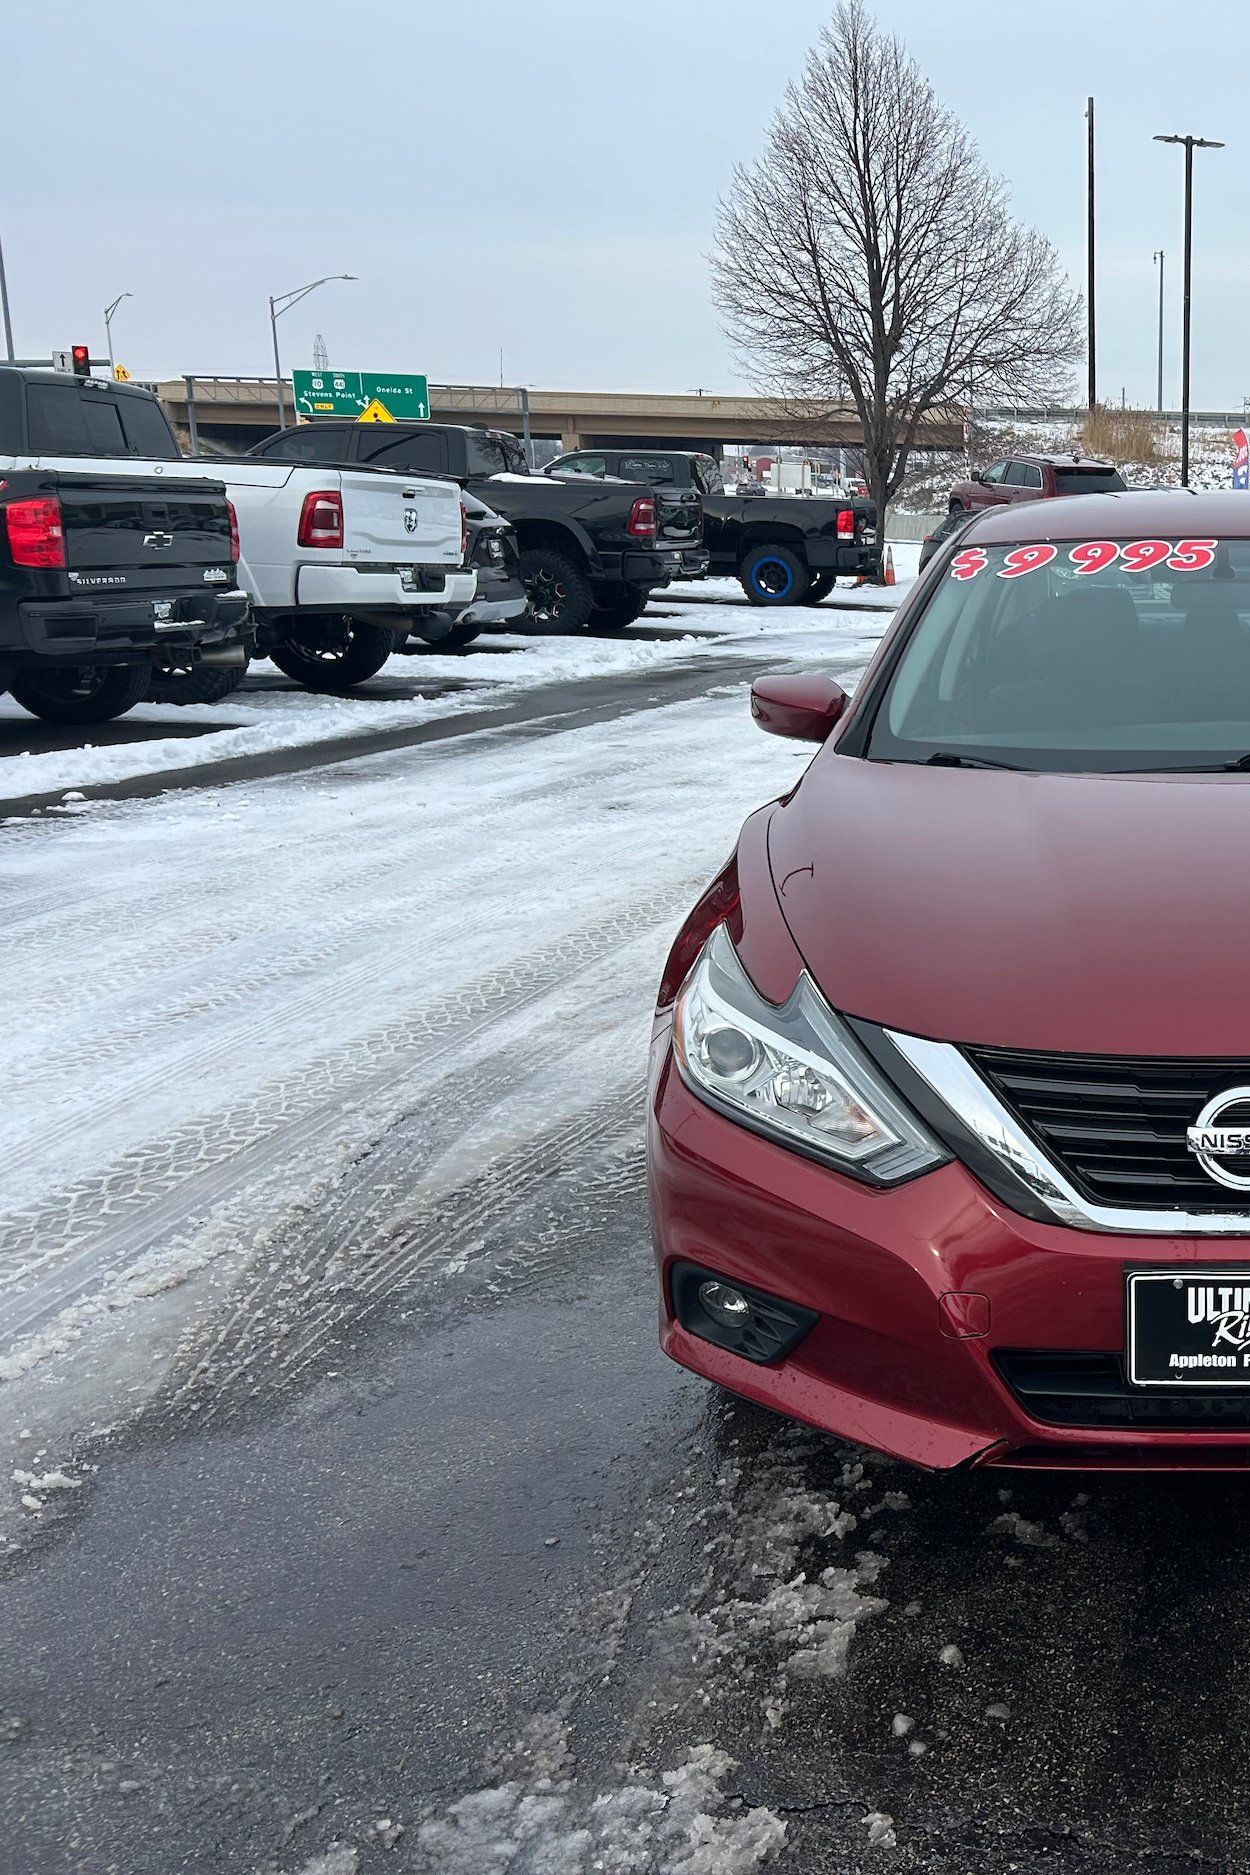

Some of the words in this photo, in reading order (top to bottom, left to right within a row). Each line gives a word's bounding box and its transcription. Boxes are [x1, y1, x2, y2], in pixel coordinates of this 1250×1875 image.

[303, 390, 333, 398] Stevens
[335, 391, 356, 399] Point
[375, 386, 402, 394] Oneida
[404, 387, 414, 395] St
[76, 576, 126, 585] SILVERADO
[1168, 1353, 1237, 1368] Appleton
